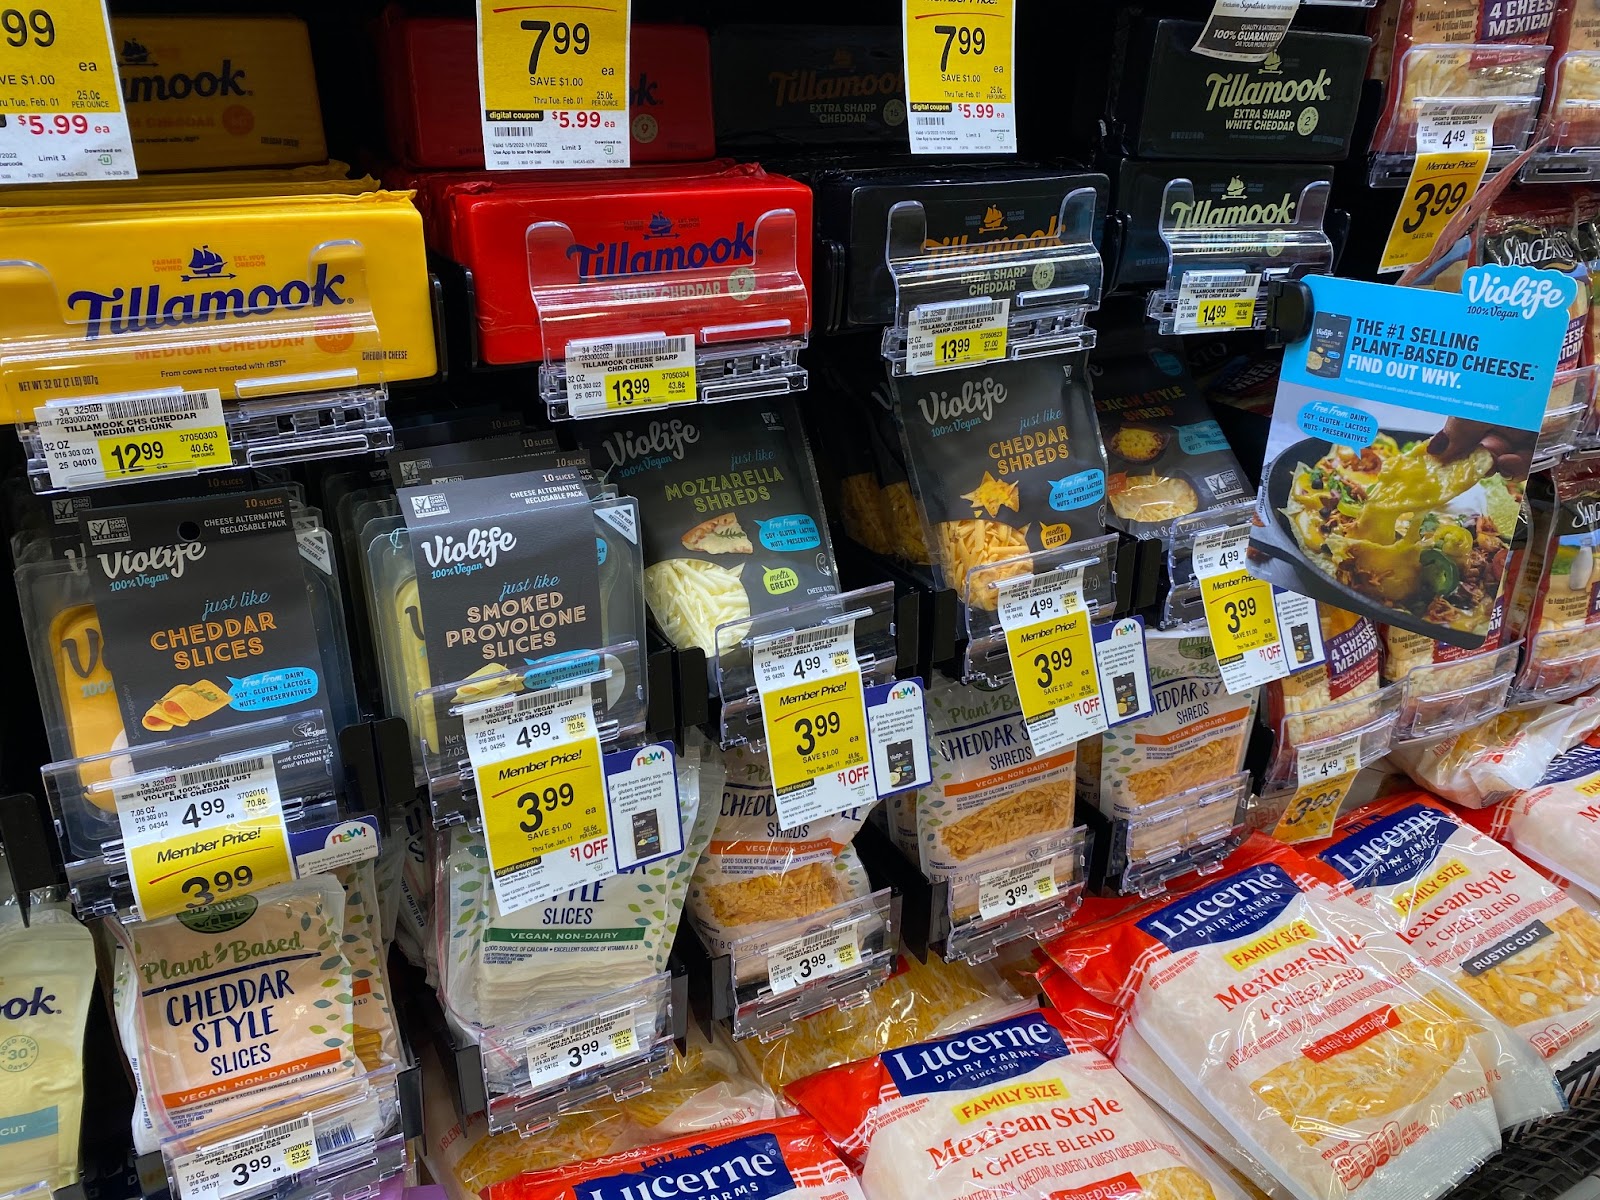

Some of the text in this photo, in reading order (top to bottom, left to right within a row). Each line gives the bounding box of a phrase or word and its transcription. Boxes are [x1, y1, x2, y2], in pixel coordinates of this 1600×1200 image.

[1489, 4, 1502, 19] 4
[1214, 30, 1283, 41] 100% GUARANTEED
[529, 77, 583, 86] SAVE $1.00
[1206, 69, 1331, 111] Tillamook
[534, 96, 548, 104] Thru
[549, 96, 561, 104] Tue.
[563, 96, 574, 104] Feb.
[1233, 109, 1291, 119] EXTRA SHARP
[552, 111, 600, 128] $5.99
[1225, 119, 1294, 131] WHITE CHEDDAR
[1170, 193, 1295, 232] Tillamook
[566, 222, 754, 283] Tillamook
[1503, 236, 1574, 266] SARGENTO
[154, 265, 183, 273] OWNED
[67, 263, 346, 341] Tillamook
[969, 280, 1016, 296] CHEDDAR
[1467, 272, 1565, 319] Violife
[1467, 305, 1519, 320] 100% Vegan
[1356, 318, 1479, 352] THE #1 SELLING
[582, 354, 678, 368] TILLAMOOK CHEESE SHARP
[1351, 336, 1464, 367] PLANT-BASED
[160, 370, 180, 378] From
[219, 364, 247, 372] treated
[607, 362, 654, 372] CHDR CHUNK
[1347, 354, 1461, 389] FIND OUT WHY.
[18, 381, 31, 392] NET
[32, 381, 42, 391] WT
[44, 380, 51, 389] 32
[52, 379, 62, 389] OZ
[917, 377, 1008, 425] Violife
[1312, 402, 1369, 422] Free From DAIRY
[64, 413, 197, 433] TILLAMOOK CHS CHEDDAR
[93, 422, 173, 437] MEDIUM CHUNK
[179, 432, 218, 442] 37050303
[1303, 412, 1371, 433] SOY GLUTEN LACTOSE
[1303, 423, 1368, 444] NUTS PRESERVATIVES
[190, 444, 214, 452] 40.6¢
[602, 419, 700, 466] Violife
[989, 425, 1069, 460] CHEDDAR
[997, 444, 1069, 475] SHREDS
[664, 466, 784, 501] MOZZARELLA
[693, 485, 771, 513] SHREDS
[204, 511, 285, 527] CHEESE ALTERNATIVE
[220, 519, 287, 534] RECLOSABLE PACK
[97, 541, 206, 579] Violife
[421, 527, 517, 568] Violife
[431, 563, 483, 580] 100% Vegan
[770, 579, 796, 591] GREAT!
[467, 591, 564, 624] SMOKED
[150, 611, 277, 651] CHEDDAR
[445, 605, 587, 648] PROVOLONE
[173, 637, 265, 670] SLICES
[482, 630, 557, 660] SLICES
[1331, 629, 1374, 660] 4 CHEESE
[1334, 636, 1378, 674] MEXICAN
[941, 722, 1019, 763] CHEDDAR
[499, 749, 582, 784] Member Price!
[636, 750, 665, 766] new!
[989, 746, 1032, 770] SHREDS
[1007, 762, 1049, 780] NON-DAIRY
[143, 774, 251, 802] VIOLIFE 100% VEGAN JUST
[848, 766, 869, 785] OFF
[156, 827, 261, 864] Member Price!
[583, 838, 608, 859] OFF
[1331, 809, 1443, 874] Lucerne
[542, 908, 593, 925] SLICES
[1151, 873, 1283, 938] Lucerne
[556, 932, 618, 941] NON-DAIRY
[1231, 925, 1311, 966] FAMILY SIZE
[1475, 927, 1540, 970] RUSTIC CUT
[139, 931, 305, 984] Plant Based
[166, 970, 295, 1027] CHEDDAR
[192, 1004, 279, 1053] STYLE
[211, 1043, 271, 1076] SLICES
[892, 1023, 1053, 1081] Lucerne
[961, 1083, 1061, 1119] FAMILY SIZE
[221, 1154, 235, 1162] NAT
[239, 1147, 262, 1159] PLANT
[266, 1134, 291, 1145] BASED
[925, 1097, 1123, 1171] Mexican Style
[972, 1128, 1116, 1180] 4 CHEESE BLEND
